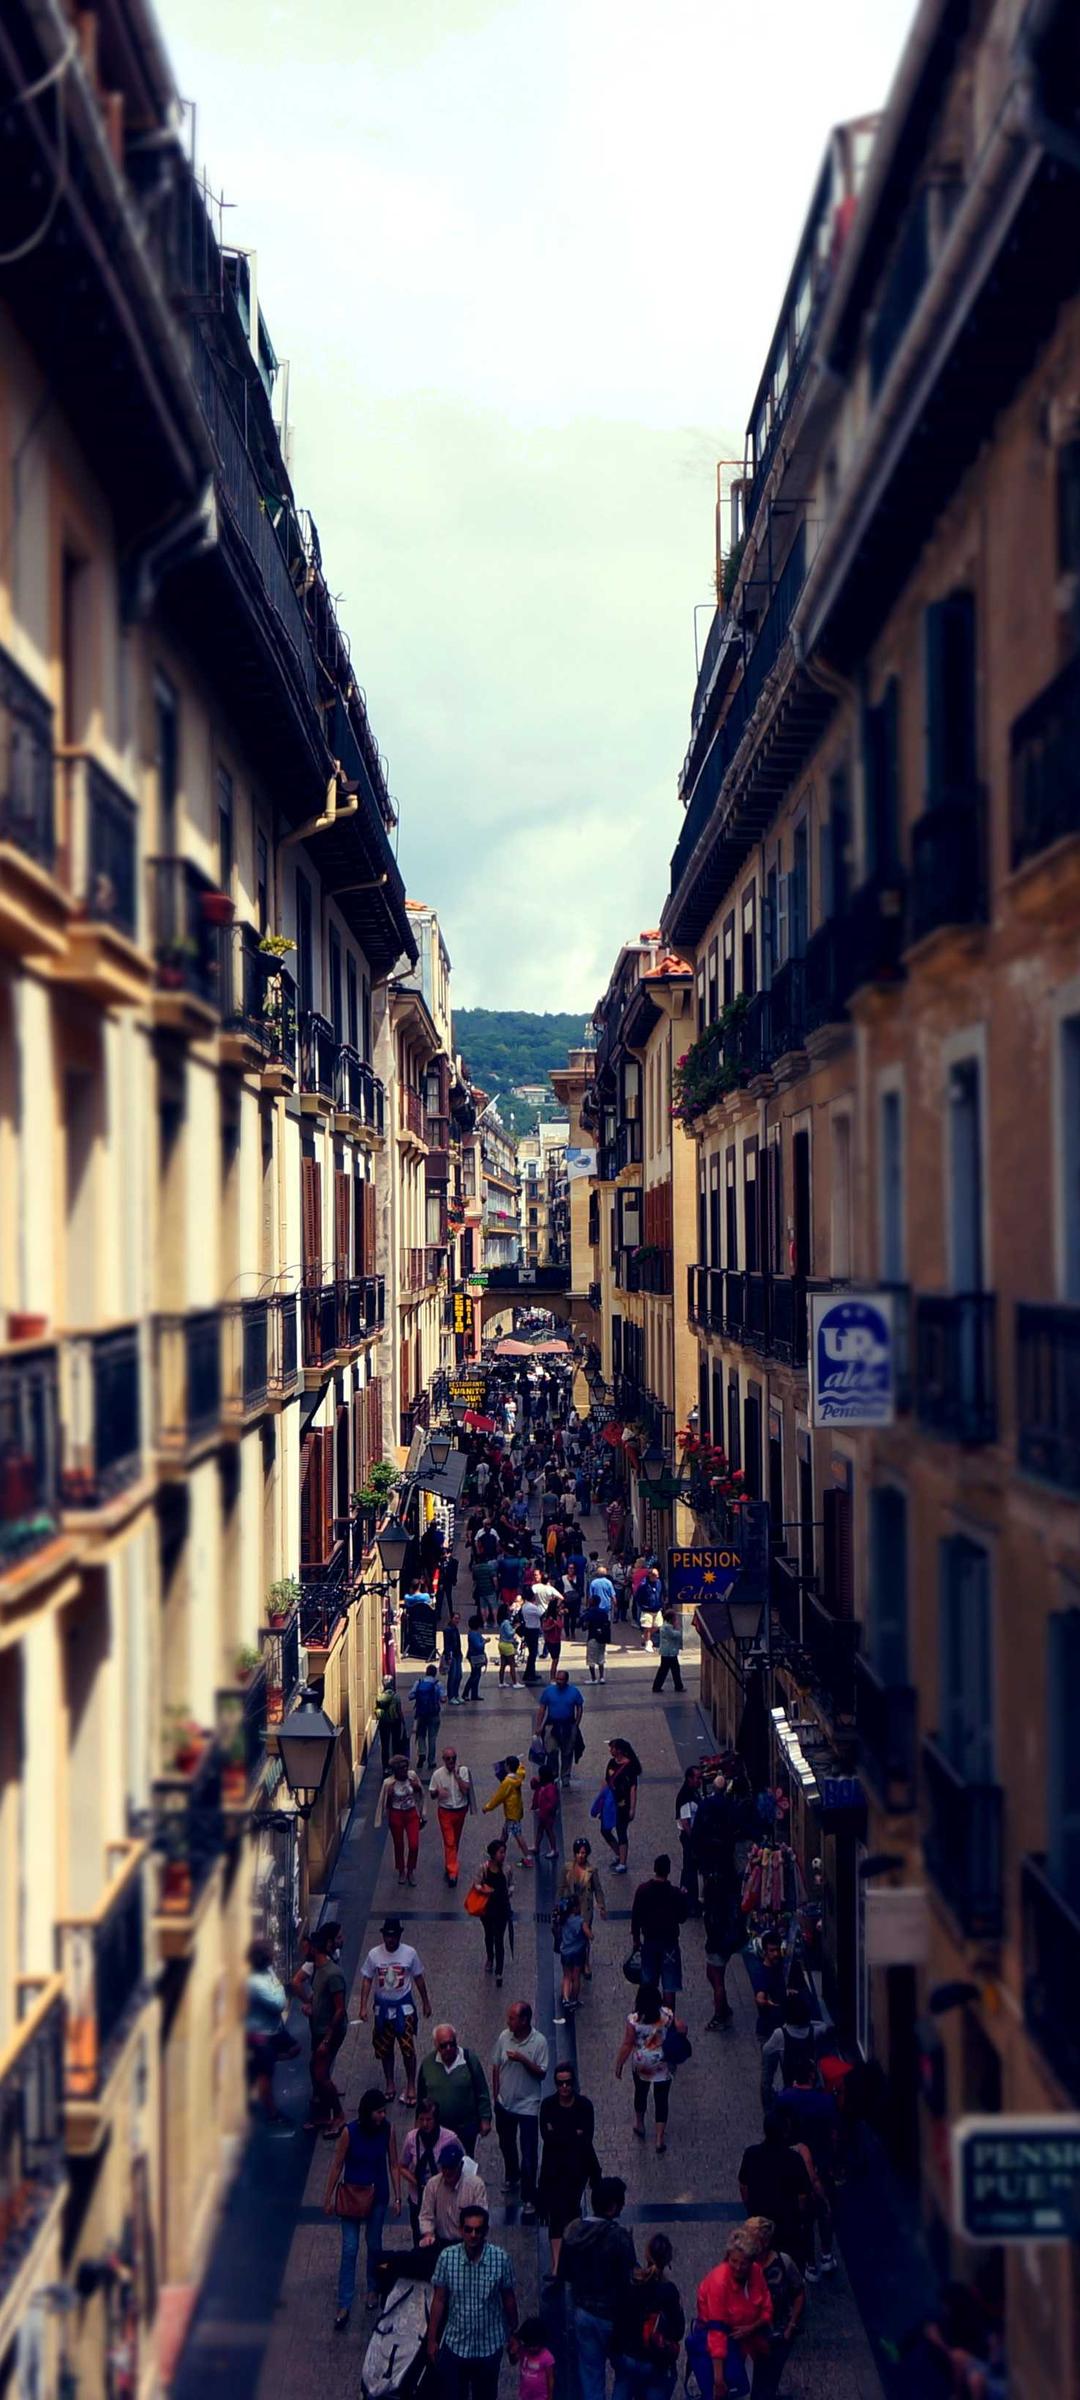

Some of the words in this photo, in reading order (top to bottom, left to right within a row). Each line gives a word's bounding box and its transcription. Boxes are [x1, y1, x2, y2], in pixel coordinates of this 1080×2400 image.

[448, 1387, 486, 1395] JUANITO
[672, 1551, 742, 1568] PENSION
[973, 2142, 1080, 2169] PENSI
